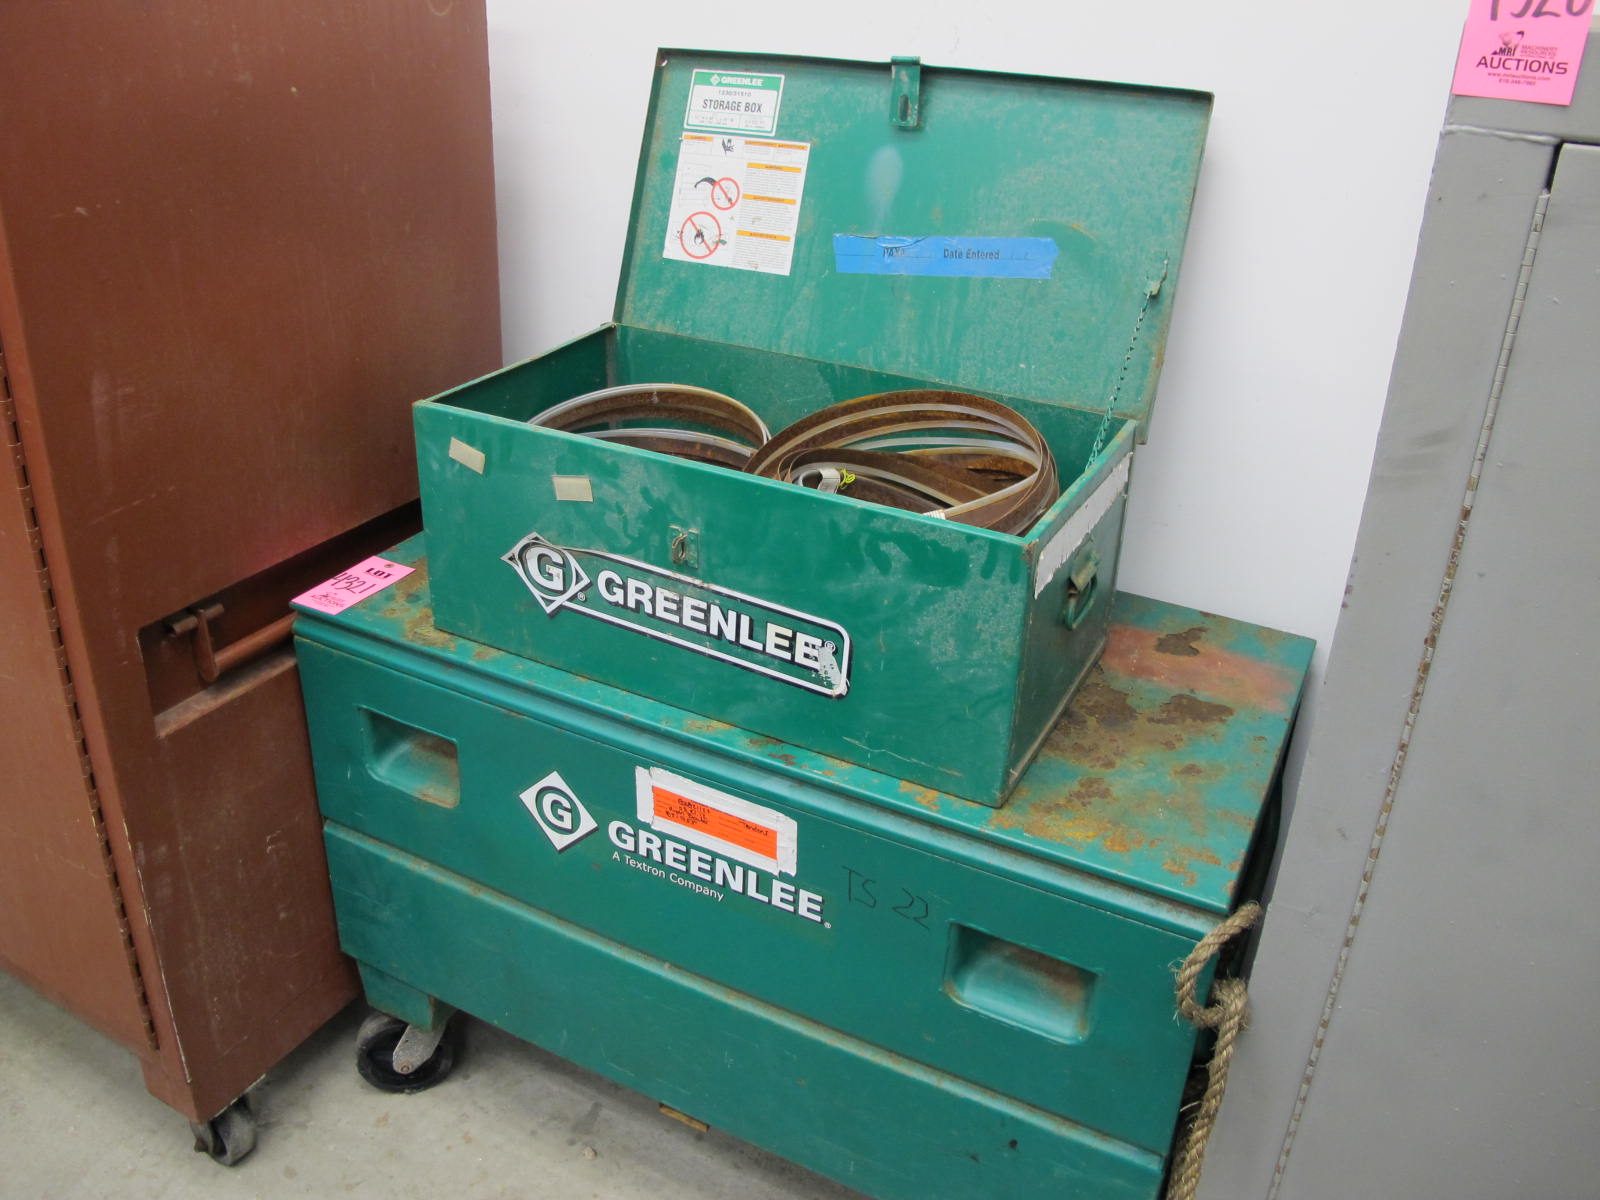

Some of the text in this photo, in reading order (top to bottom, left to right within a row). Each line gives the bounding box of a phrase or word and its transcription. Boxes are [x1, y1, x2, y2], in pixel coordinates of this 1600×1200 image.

[1498, 47, 1517, 56] MRI
[1476, 56, 1568, 75] AUCTIONS
[720, 76, 764, 87] GREENLEE
[702, 98, 763, 113] STORAGE BOX
[943, 248, 999, 260] Date Entered
[365, 567, 392, 579] LOT
[330, 572, 376, 594] 4321
[597, 569, 826, 669] GREENLEE
[607, 820, 823, 922] GREENLEE
[612, 851, 724, 902] A Textron Company
